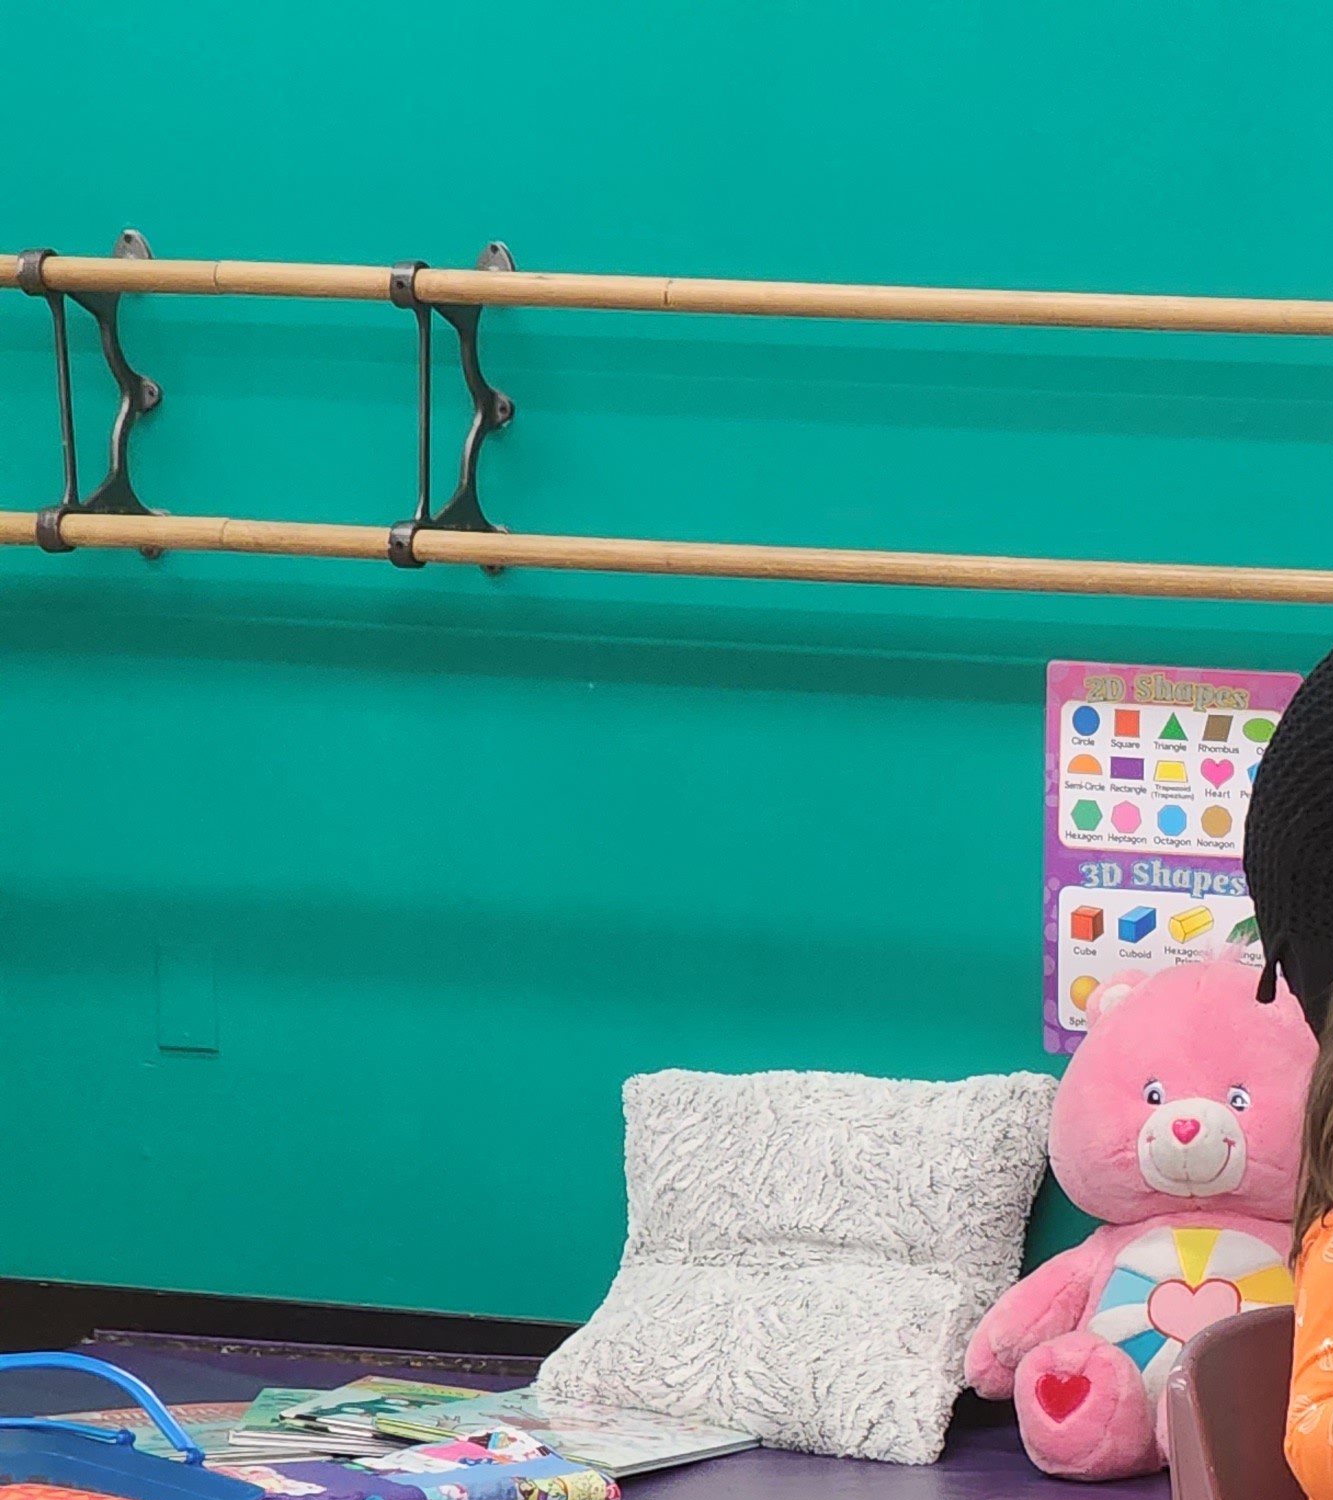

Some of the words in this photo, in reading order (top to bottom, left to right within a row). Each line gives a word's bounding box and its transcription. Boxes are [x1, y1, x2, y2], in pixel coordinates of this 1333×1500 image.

[1085, 675, 1124, 703] 2D
[1134, 674, 1248, 712] Shapes
[1072, 737, 1095, 747] Circle
[1110, 739, 1140, 749] Square
[1153, 741, 1187, 753] Triangle
[1198, 744, 1239, 755] Rhombus
[1065, 781, 1105, 792] Semi-Circle
[1110, 784, 1147, 795] Rectangle
[1205, 789, 1230, 798] Heart
[1065, 832, 1103, 843] Hexagon
[1108, 834, 1147, 846] Heptagon
[1153, 837, 1192, 849] Octagon
[1197, 839, 1235, 851] Nonagon
[1080, 862, 1123, 889] 3D
[1132, 859, 1247, 899] Shapes
[1073, 947, 1097, 956] Cube
[1119, 949, 1152, 959] Cuboid
